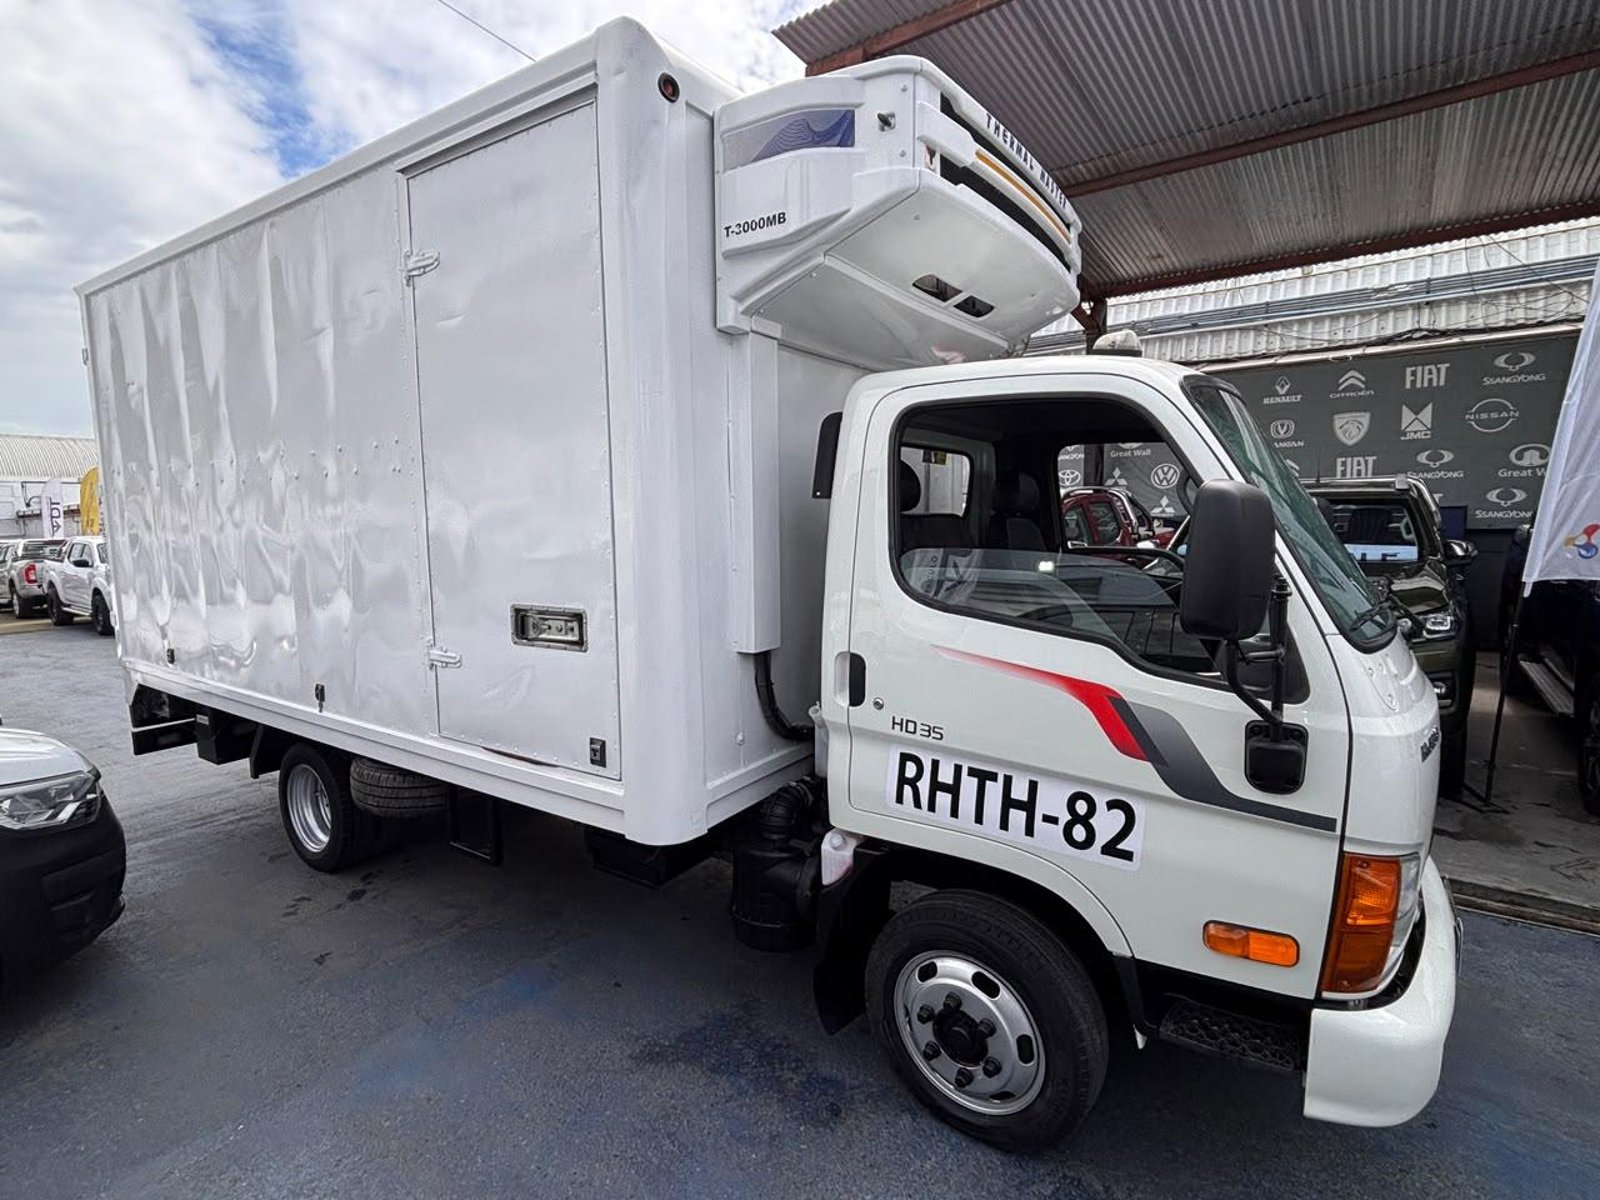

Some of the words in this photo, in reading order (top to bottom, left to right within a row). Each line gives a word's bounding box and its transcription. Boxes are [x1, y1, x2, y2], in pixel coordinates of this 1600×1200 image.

[724, 212, 786, 238] T-3000MB
[1405, 363, 1451, 389] FIAT
[1482, 373, 1547, 386] SSANGYONG
[1263, 394, 1302, 405] RENAULT
[1465, 410, 1520, 420] NISSAN
[1400, 430, 1432, 440] JMC
[1336, 456, 1378, 479] FIAT
[1498, 468, 1534, 477] Great
[1474, 509, 1534, 519] SSANGYON
[894, 751, 1137, 863] RHTH-82
